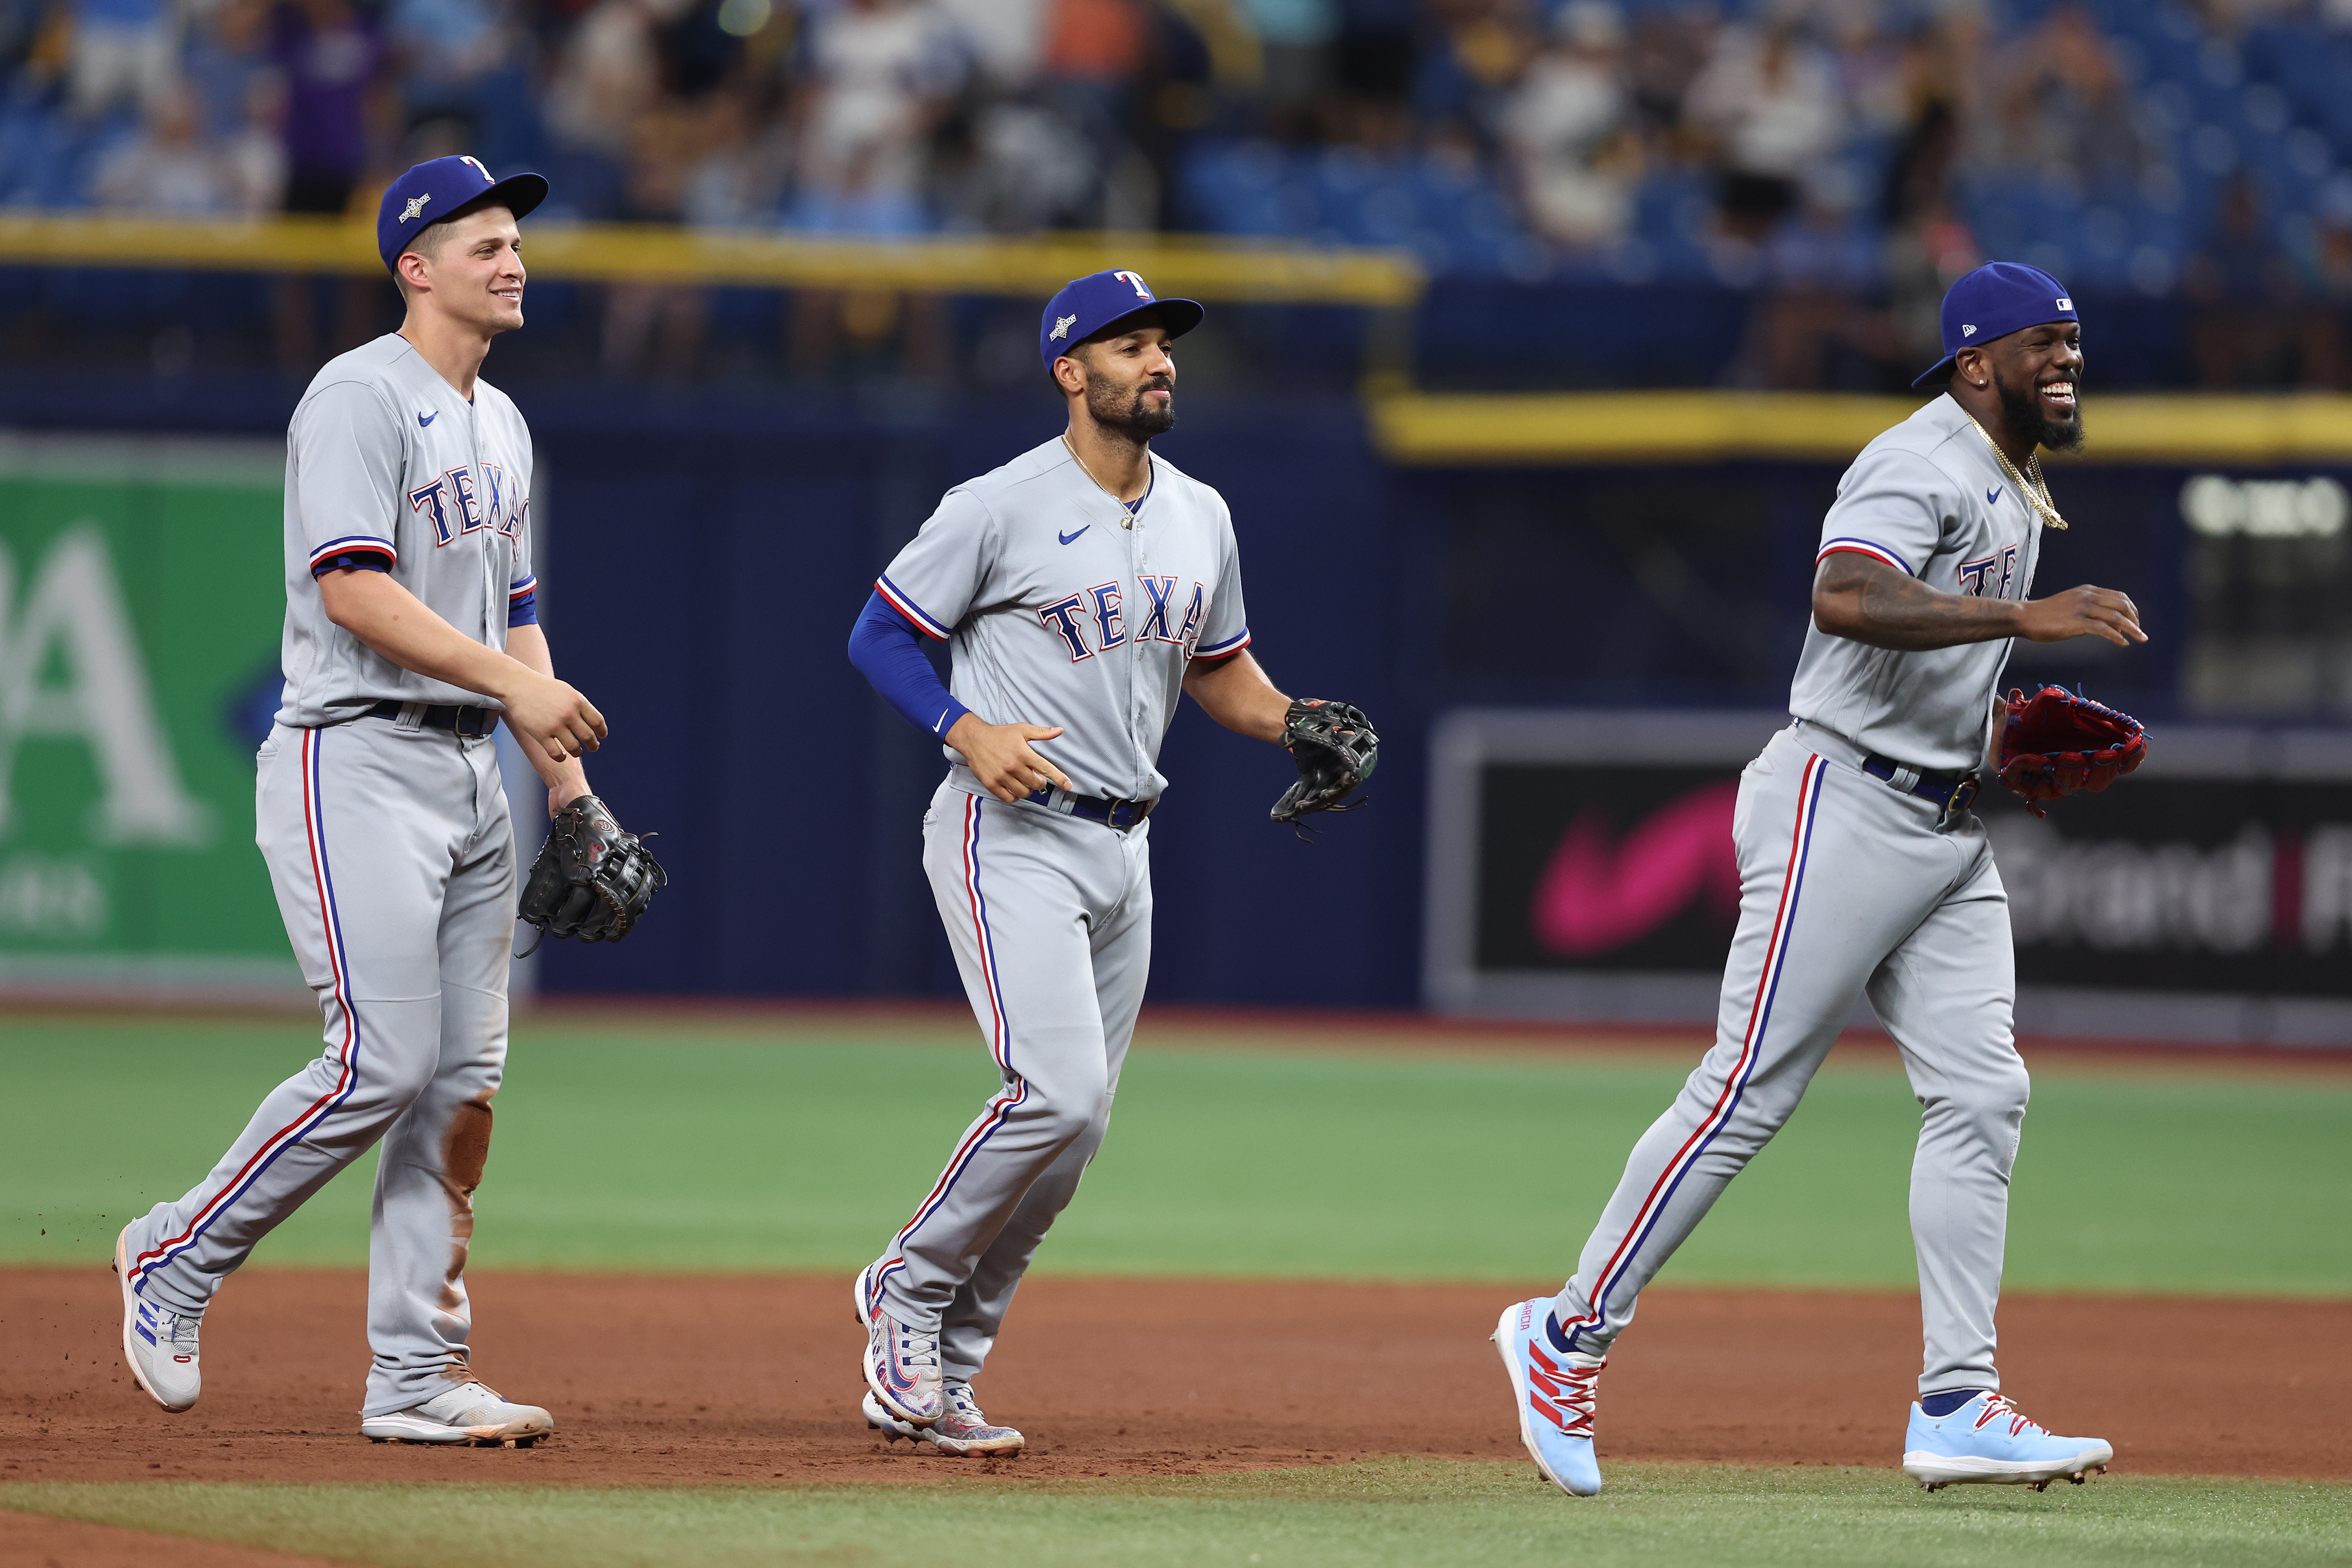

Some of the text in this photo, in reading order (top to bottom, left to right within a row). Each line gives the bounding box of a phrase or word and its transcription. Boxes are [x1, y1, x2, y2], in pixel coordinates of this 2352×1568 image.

[459, 156, 496, 184] T
[399, 194, 430, 221] POSTSEASON
[1114, 271, 1150, 300] T
[1049, 315, 1076, 341] POSTSEASON
[1520, 1300, 1535, 1330] GARCIA
